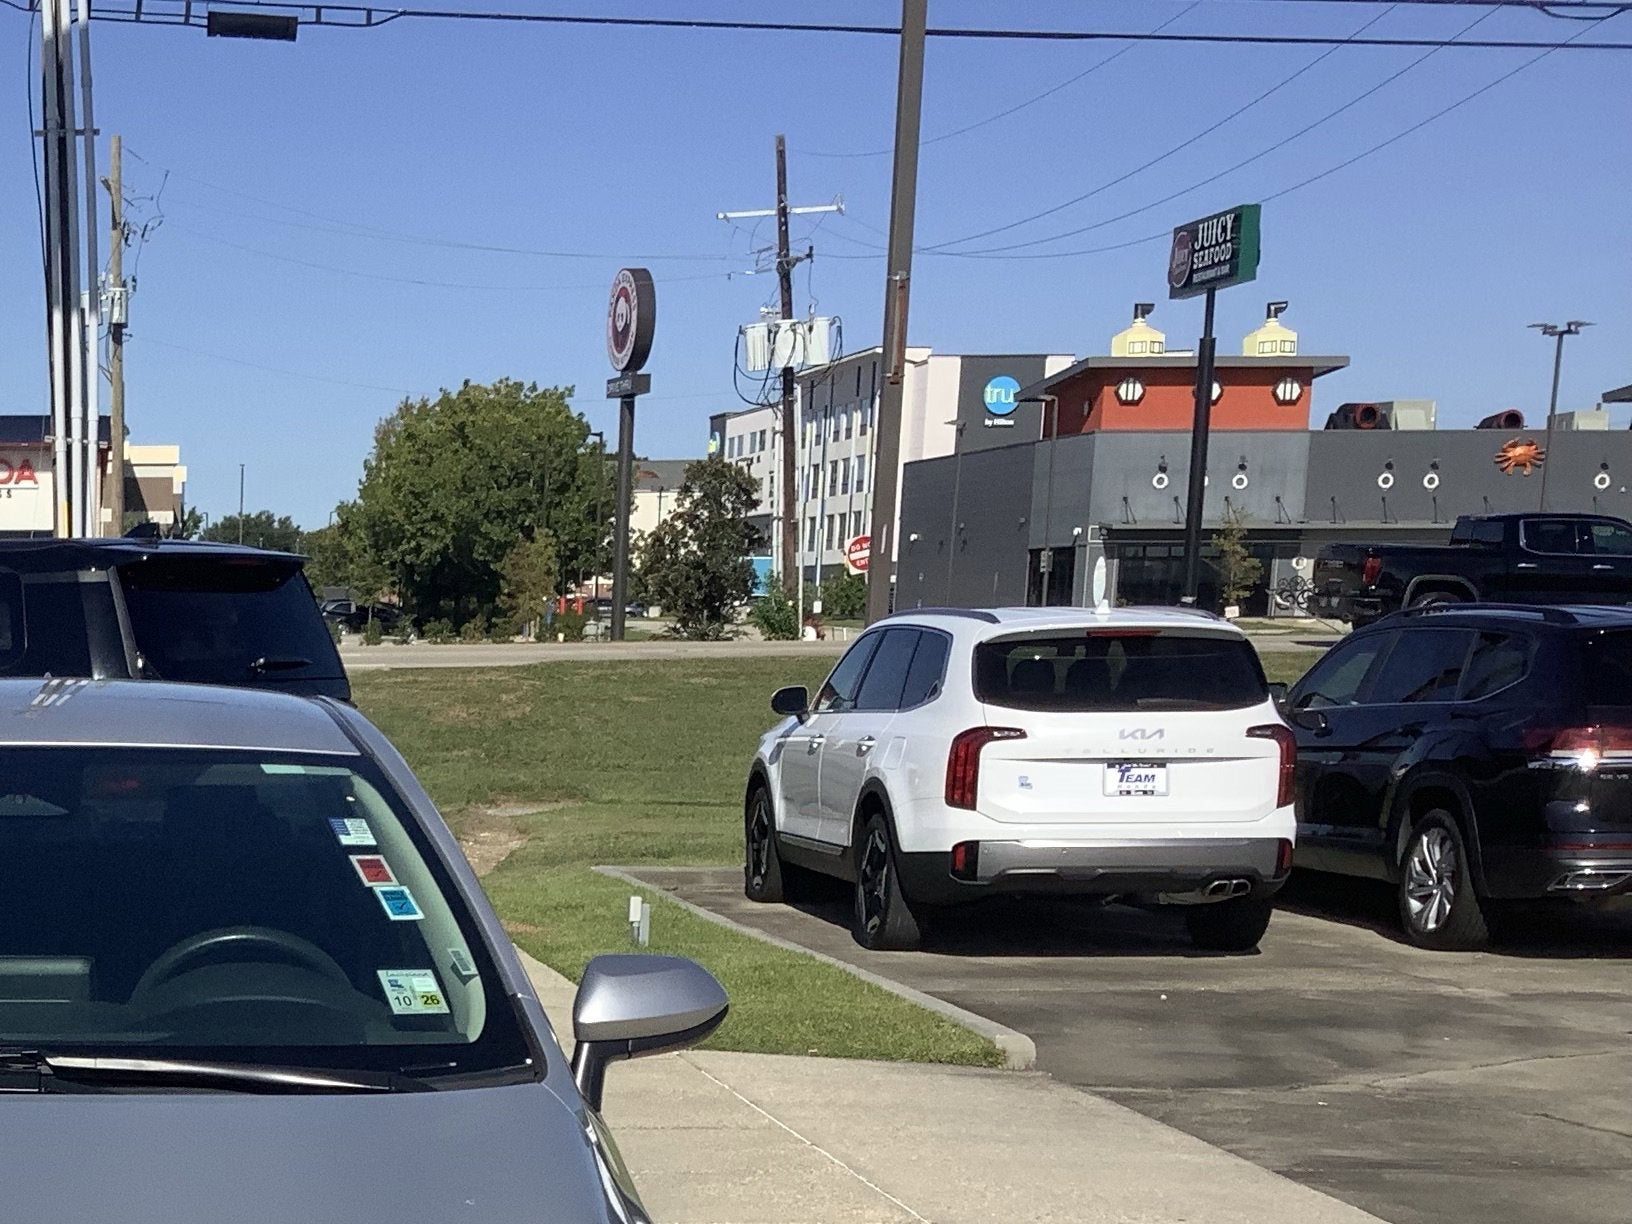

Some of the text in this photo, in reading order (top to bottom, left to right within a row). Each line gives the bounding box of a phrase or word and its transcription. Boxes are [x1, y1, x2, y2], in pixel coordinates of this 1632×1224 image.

[1194, 213, 1235, 250] JUICY
[1193, 242, 1232, 269] SEAFOOD
[985, 384, 1014, 404] tru
[851, 543, 861, 552] DO
[1118, 766, 1156, 783] TEAM
[394, 994, 440, 1006] 10 26
